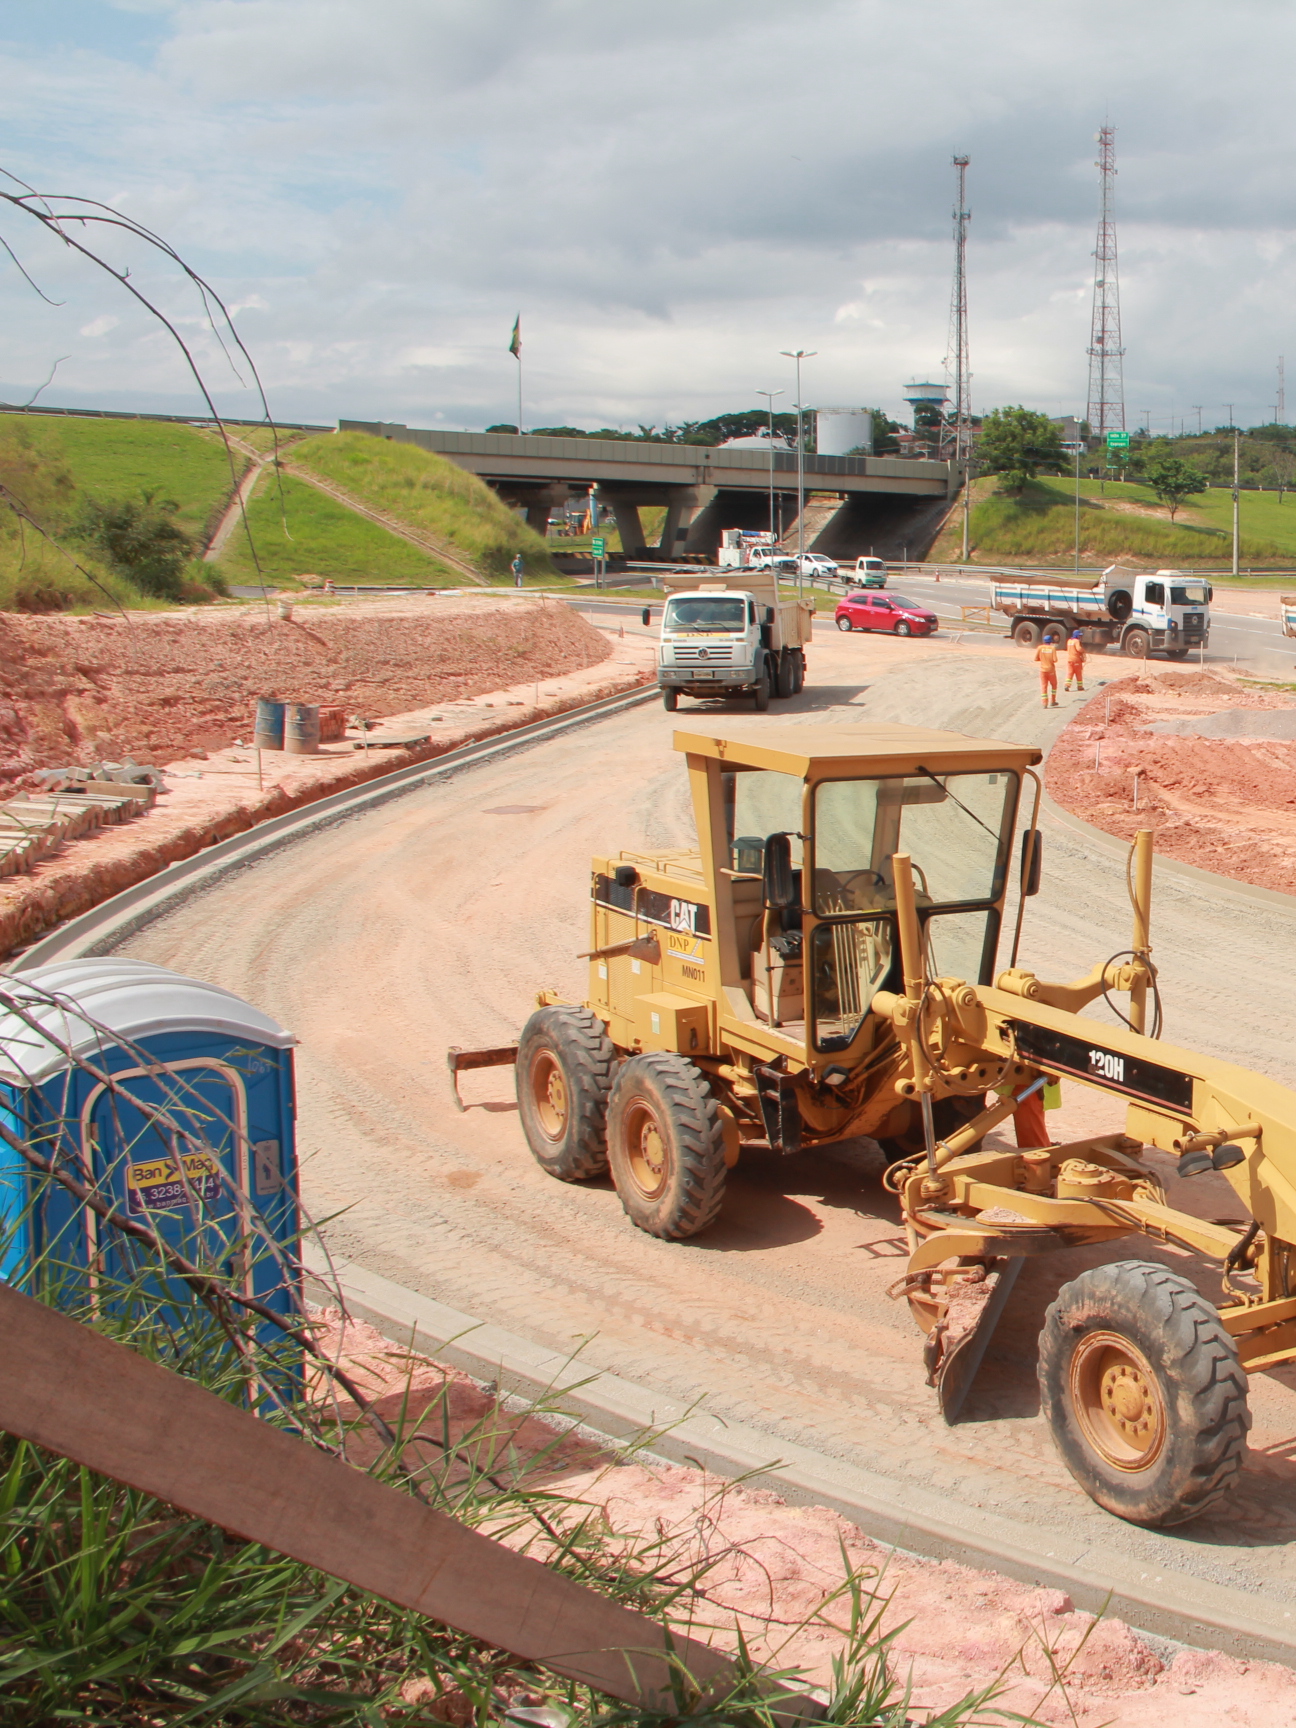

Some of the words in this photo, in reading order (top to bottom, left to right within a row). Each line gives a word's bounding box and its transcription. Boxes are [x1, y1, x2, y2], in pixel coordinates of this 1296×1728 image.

[671, 899, 698, 934] CAT
[669, 935, 689, 952] DNP
[682, 964, 706, 983] MN011
[1088, 1050, 1124, 1082] 120H
[133, 1167, 163, 1182] Ban
